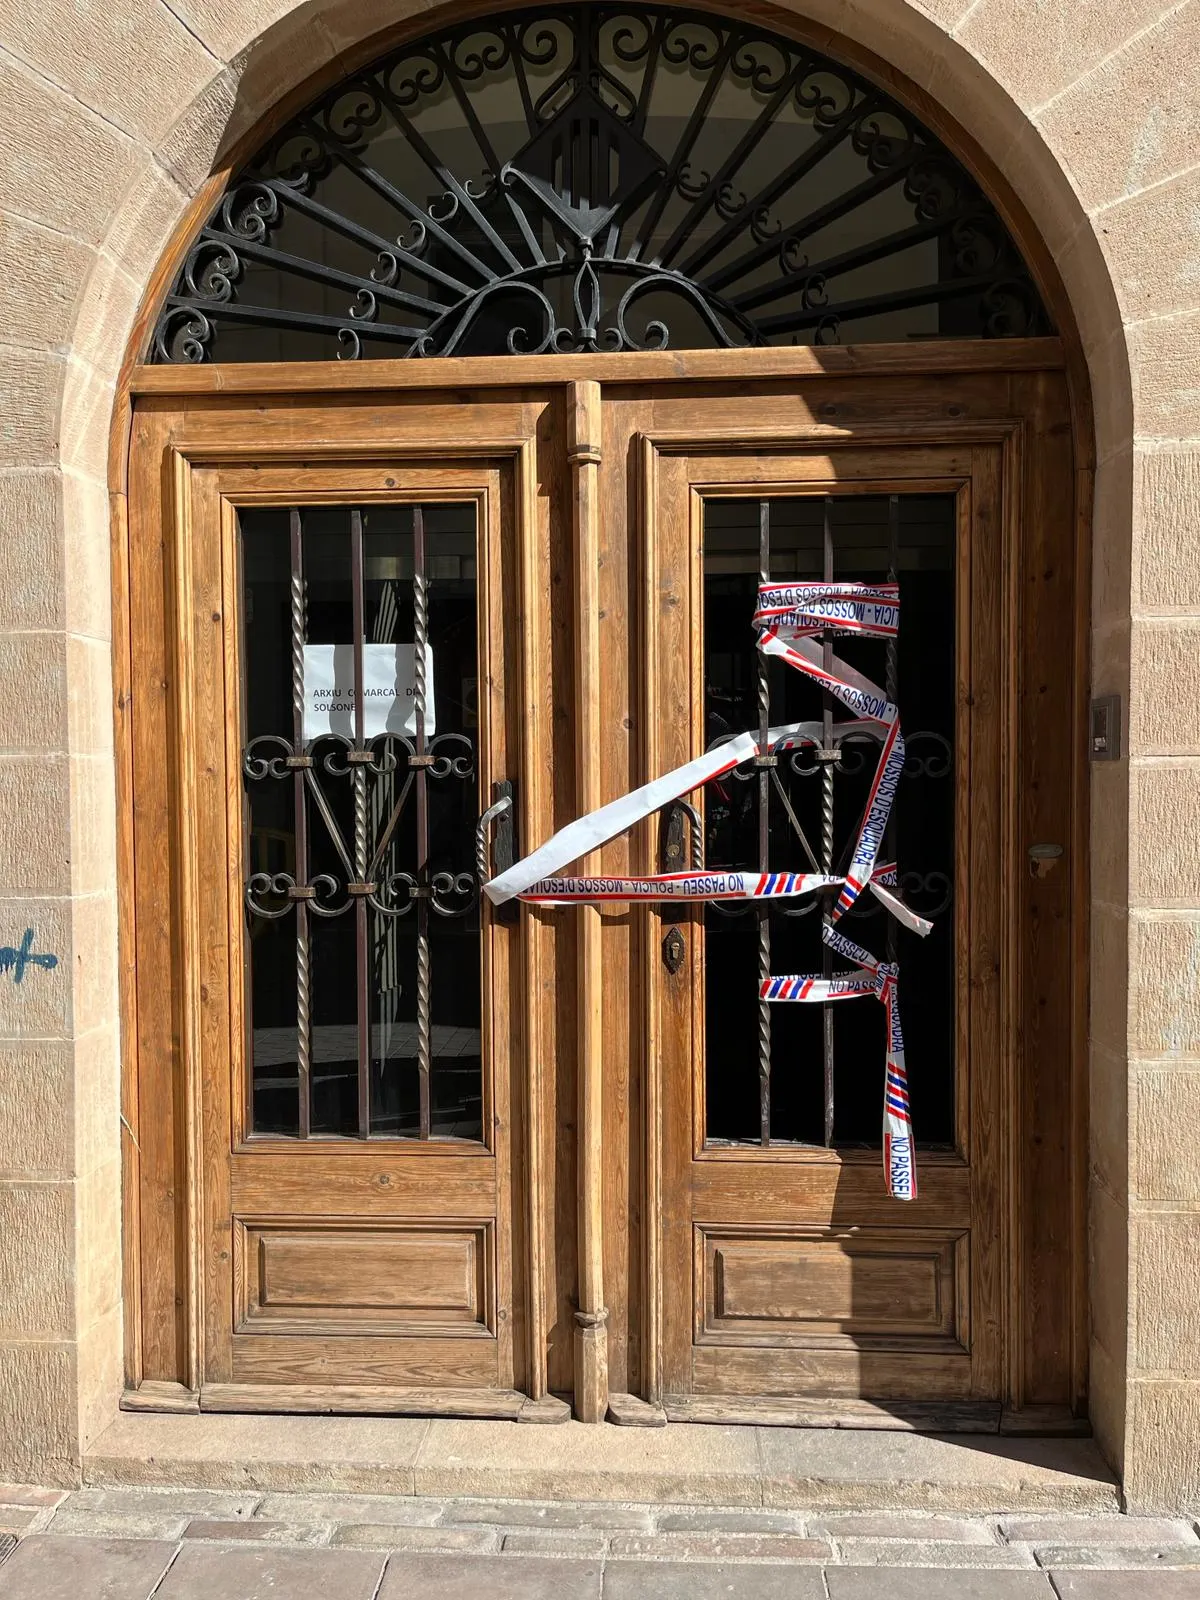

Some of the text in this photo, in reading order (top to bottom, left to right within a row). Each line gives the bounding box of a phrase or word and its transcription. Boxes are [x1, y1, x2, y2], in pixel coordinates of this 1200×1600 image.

[819, 598, 866, 622] MOSSOS
[313, 688, 342, 697] ARXIU
[347, 688, 401, 697] CMARCAL
[313, 701, 356, 712] SOLSONÈ
[842, 687, 888, 719] MOSSOS
[878, 750, 905, 798] MOSSOS
[853, 798, 894, 866] D'ESQUADRA
[578, 879, 622, 893] MOSSOS
[630, 881, 674, 894] POLICIA
[683, 877, 724, 894] PASSEU
[728, 874, 745, 893] NO
[828, 931, 869, 962] PASSEU
[829, 980, 875, 993] NO PASS
[891, 1136, 909, 1153] NO
